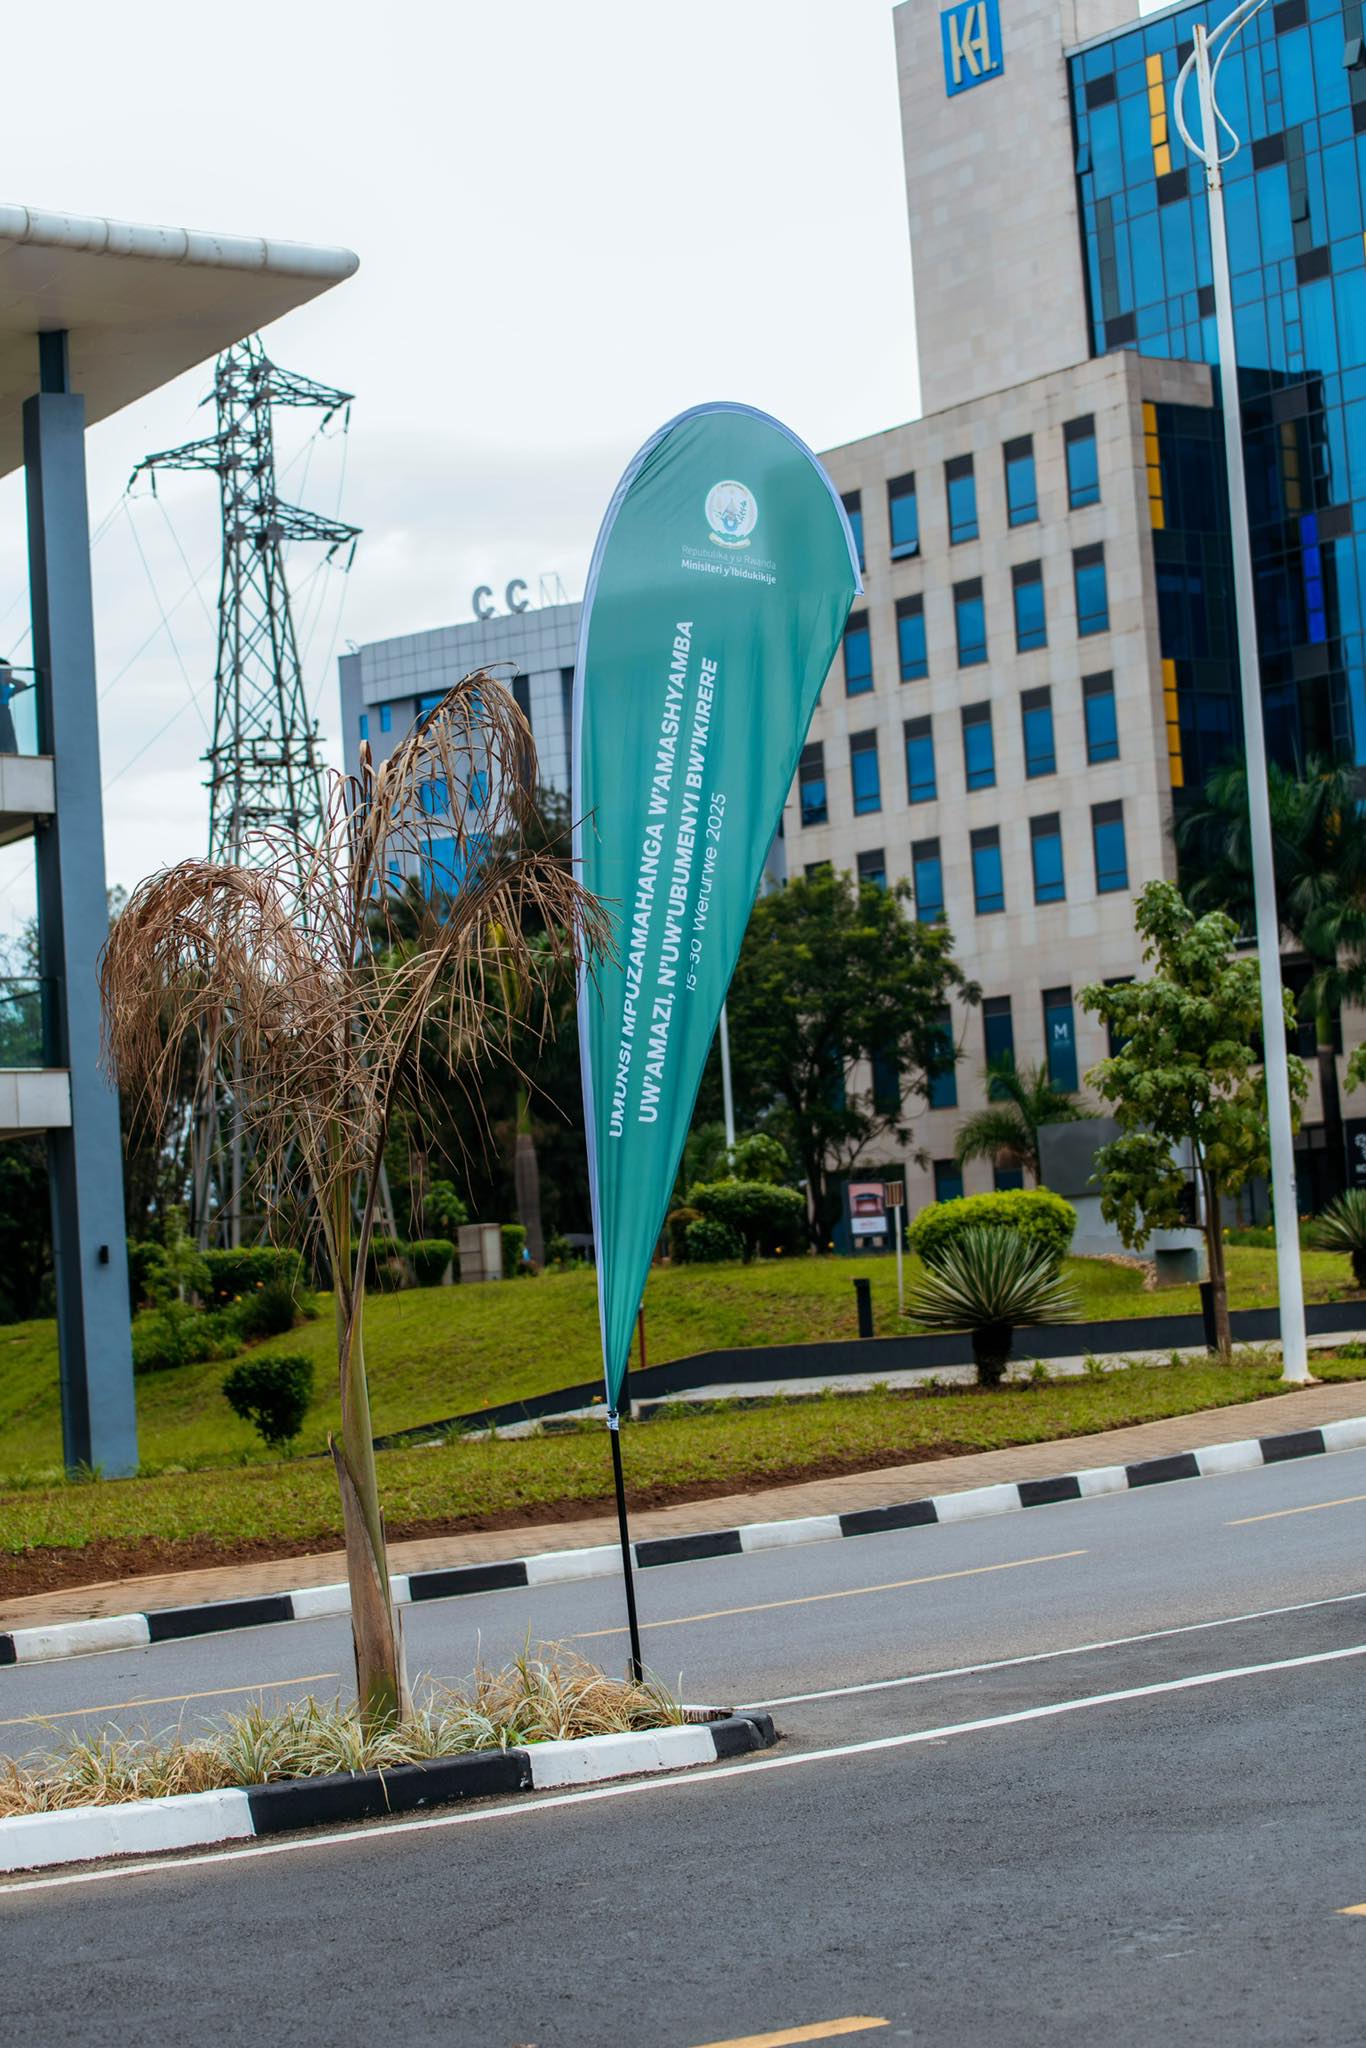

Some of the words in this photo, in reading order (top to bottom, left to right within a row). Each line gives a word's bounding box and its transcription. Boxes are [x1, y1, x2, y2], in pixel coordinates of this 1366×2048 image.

[681, 559, 722, 574] Minisiteri
[723, 566, 777, 585] y'Ibidukikije
[744, 555, 777, 570] Rwanda
[705, 792, 727, 842] 2025
[608, 1039, 633, 1138] UMUNSI
[621, 823, 665, 1038] MPUZAMAHANGA
[647, 621, 694, 816] W'AMASHYAMBA
[638, 992, 676, 1124] UW'AMAZI,
[657, 792, 701, 988] N'UW'UBUMENYI
[685, 656, 718, 790] BW'IKIRERE
[692, 846, 718, 932] Werurwe
[685, 938, 703, 991] 15-30
